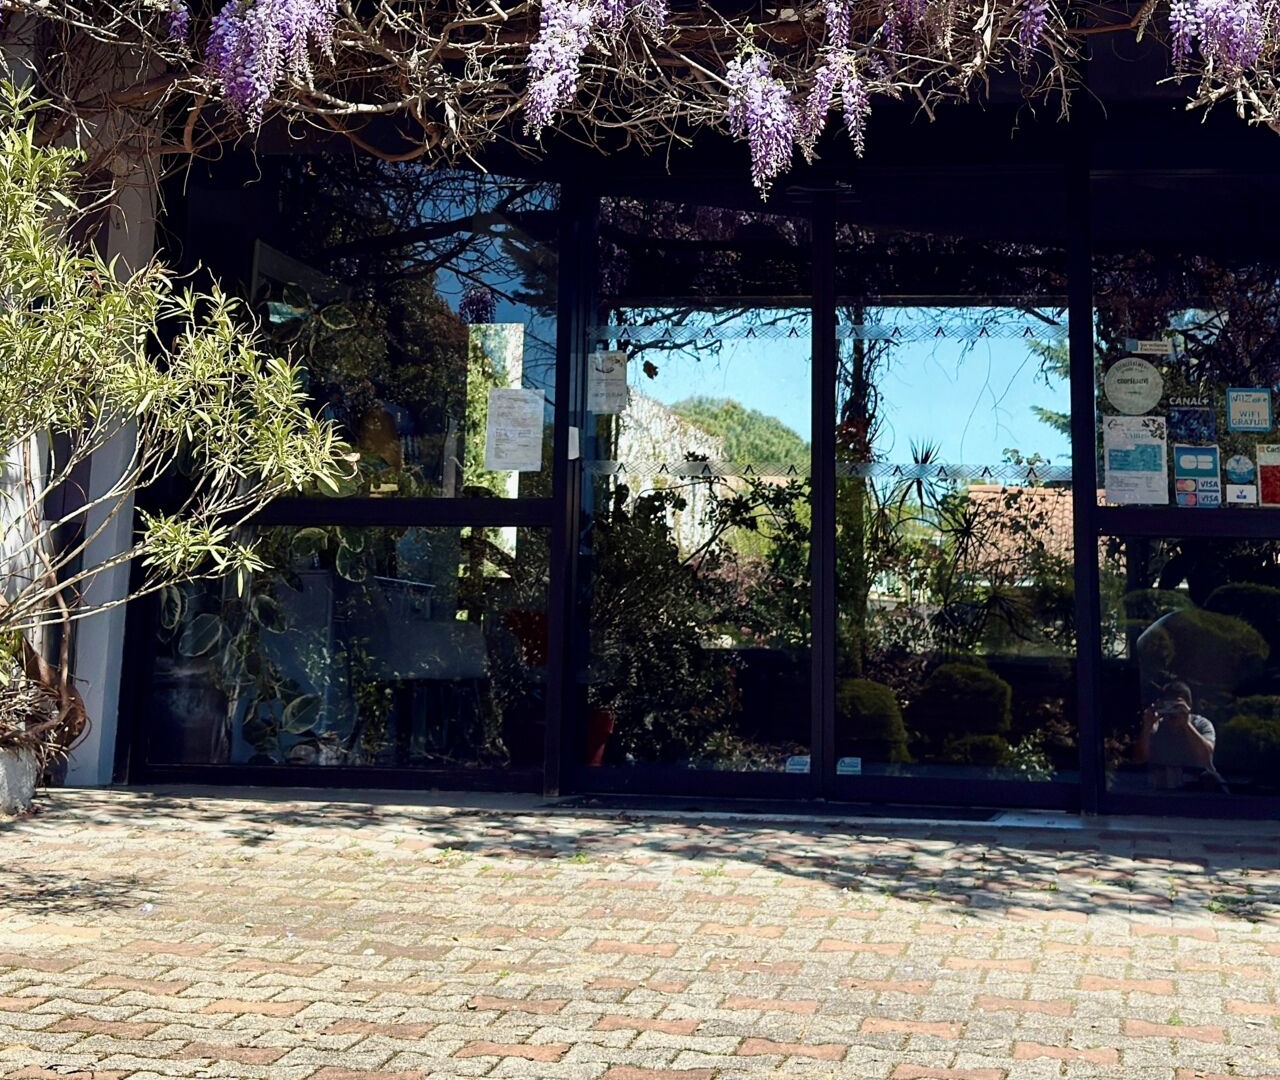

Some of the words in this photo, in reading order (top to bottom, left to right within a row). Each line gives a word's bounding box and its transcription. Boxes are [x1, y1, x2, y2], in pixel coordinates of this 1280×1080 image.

[1169, 396, 1210, 405] CANAL+
[1200, 480, 1219, 488] VISA
[1201, 495, 1219, 504] VISA
